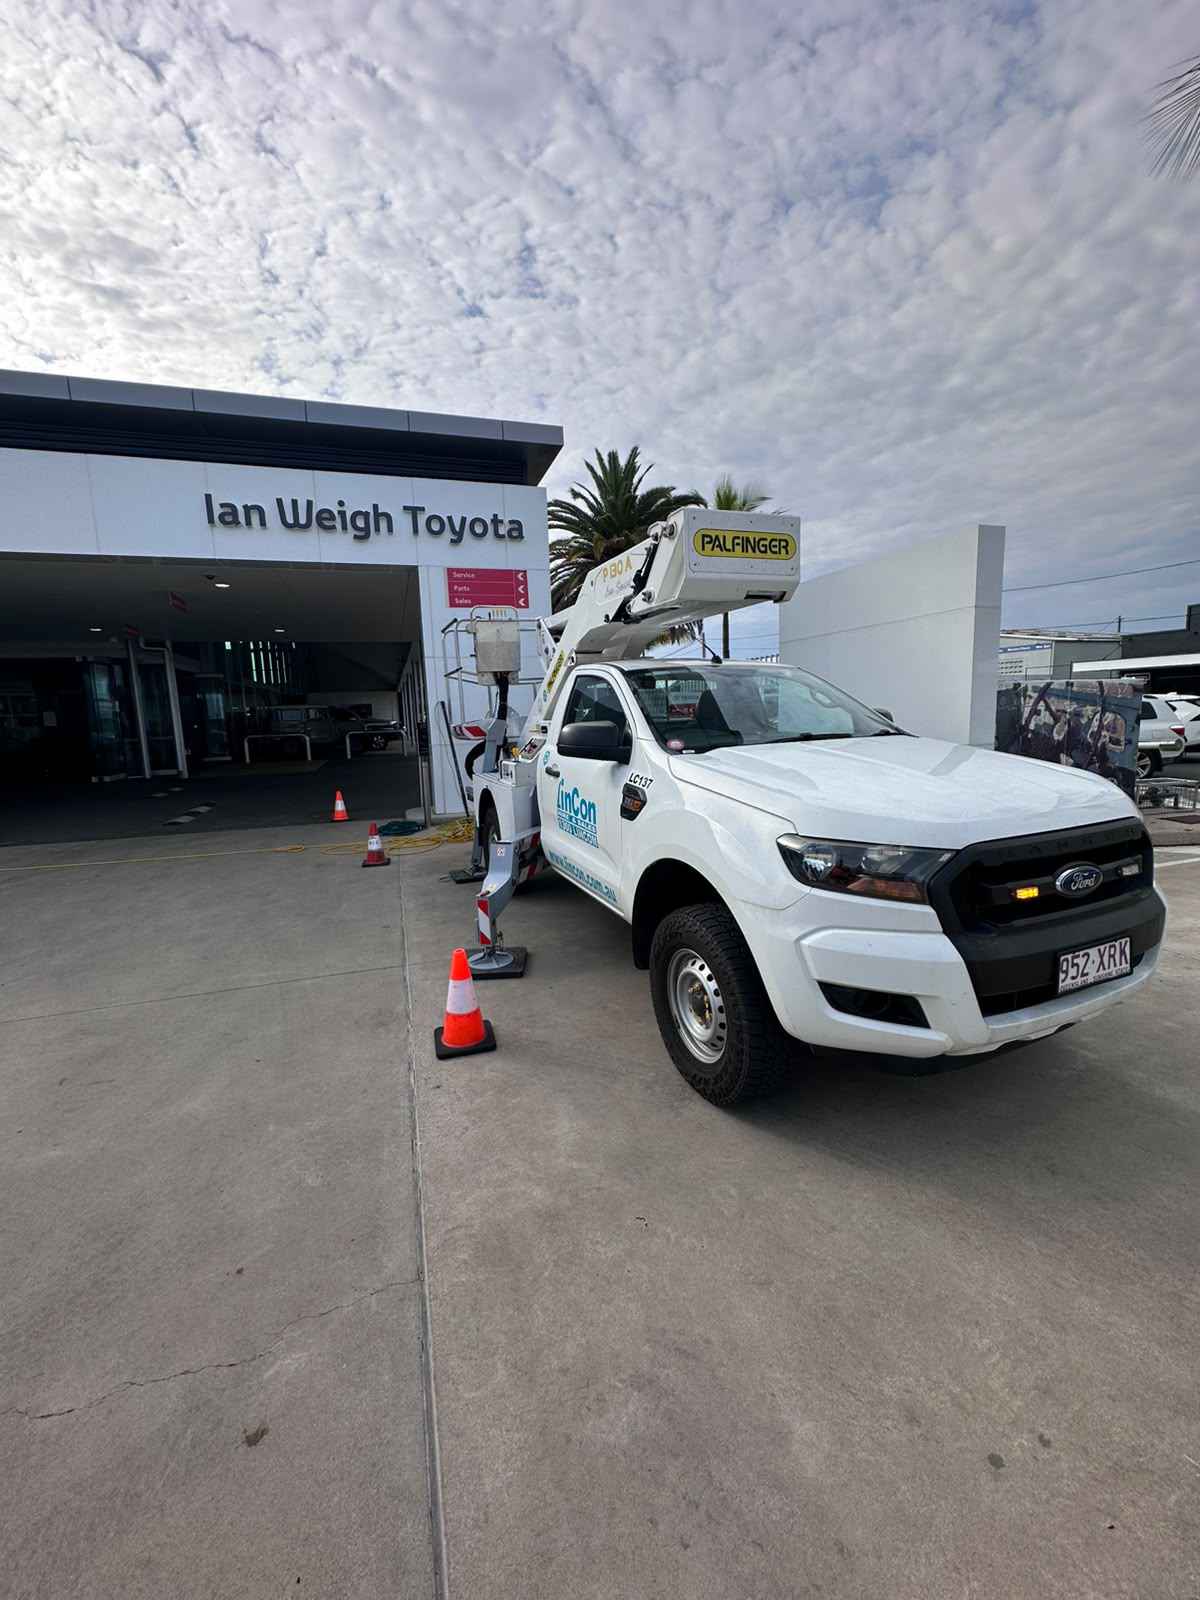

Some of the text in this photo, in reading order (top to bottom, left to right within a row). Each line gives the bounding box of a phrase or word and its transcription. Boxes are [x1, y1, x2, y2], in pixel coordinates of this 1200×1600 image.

[204, 493, 525, 544] Ian Weigh Toyota
[701, 533, 790, 556] PALFINGER
[628, 772, 654, 789] LC137
[1070, 871, 1097, 890] Ford
